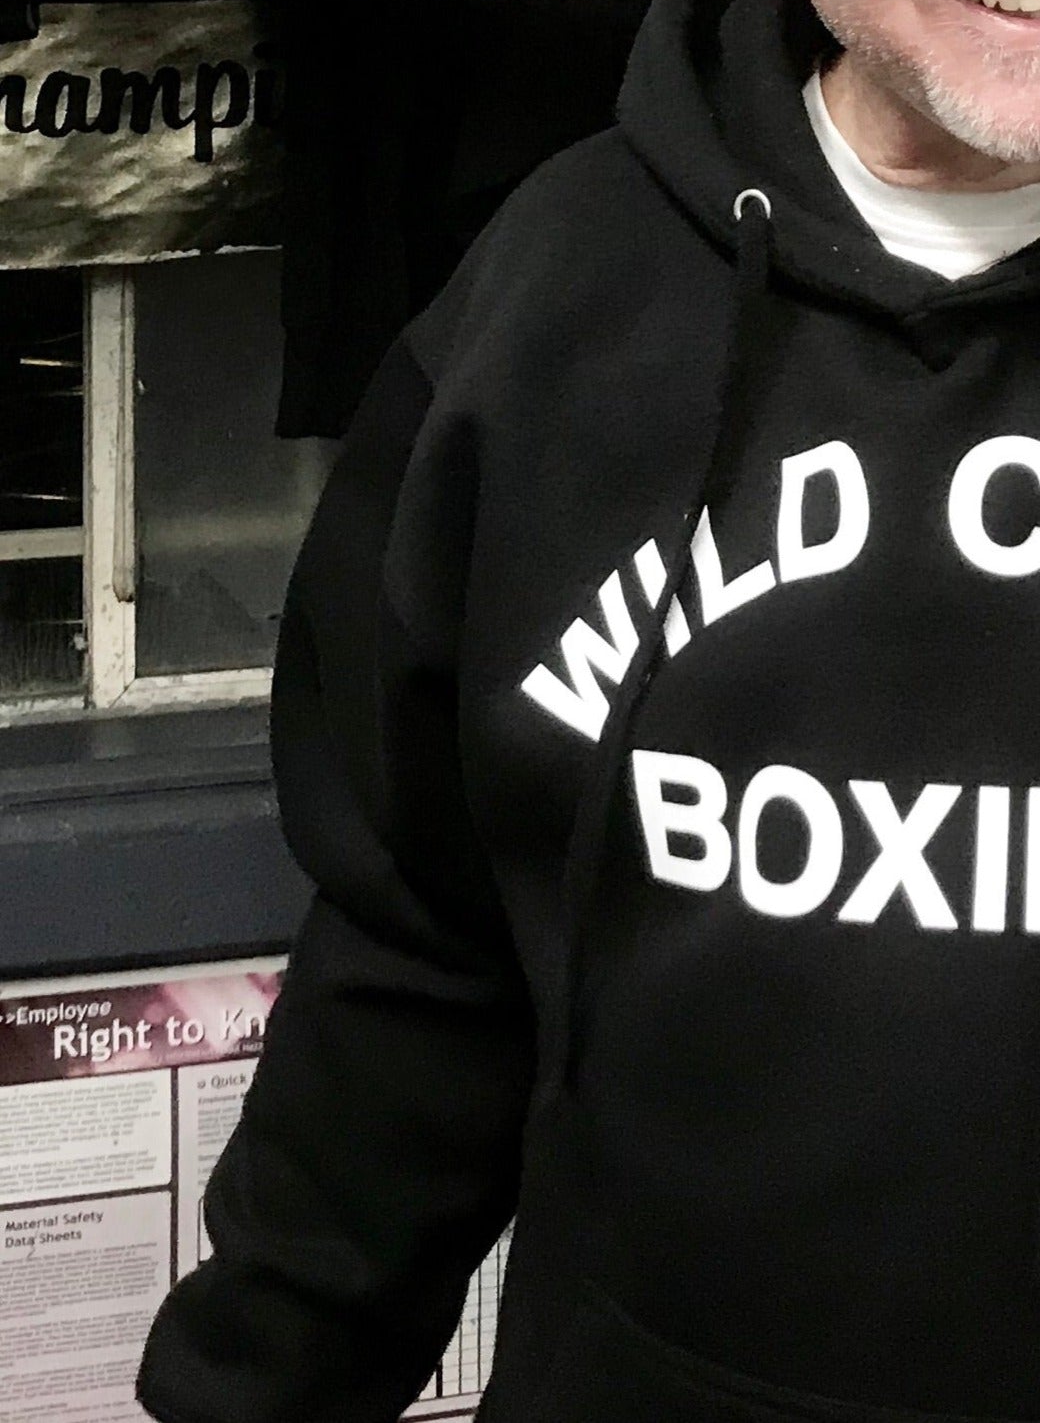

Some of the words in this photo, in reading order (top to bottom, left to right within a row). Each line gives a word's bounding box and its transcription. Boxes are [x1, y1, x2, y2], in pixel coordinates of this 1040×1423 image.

[519, 440, 871, 743] WILD
[54, 1018, 152, 1062] Right
[166, 1015, 205, 1046] to
[5, 1215, 59, 1232] Material
[63, 1211, 104, 1225] Safety
[5, 1235, 36, 1248] Data
[39, 1230, 83, 1244] Sheets
